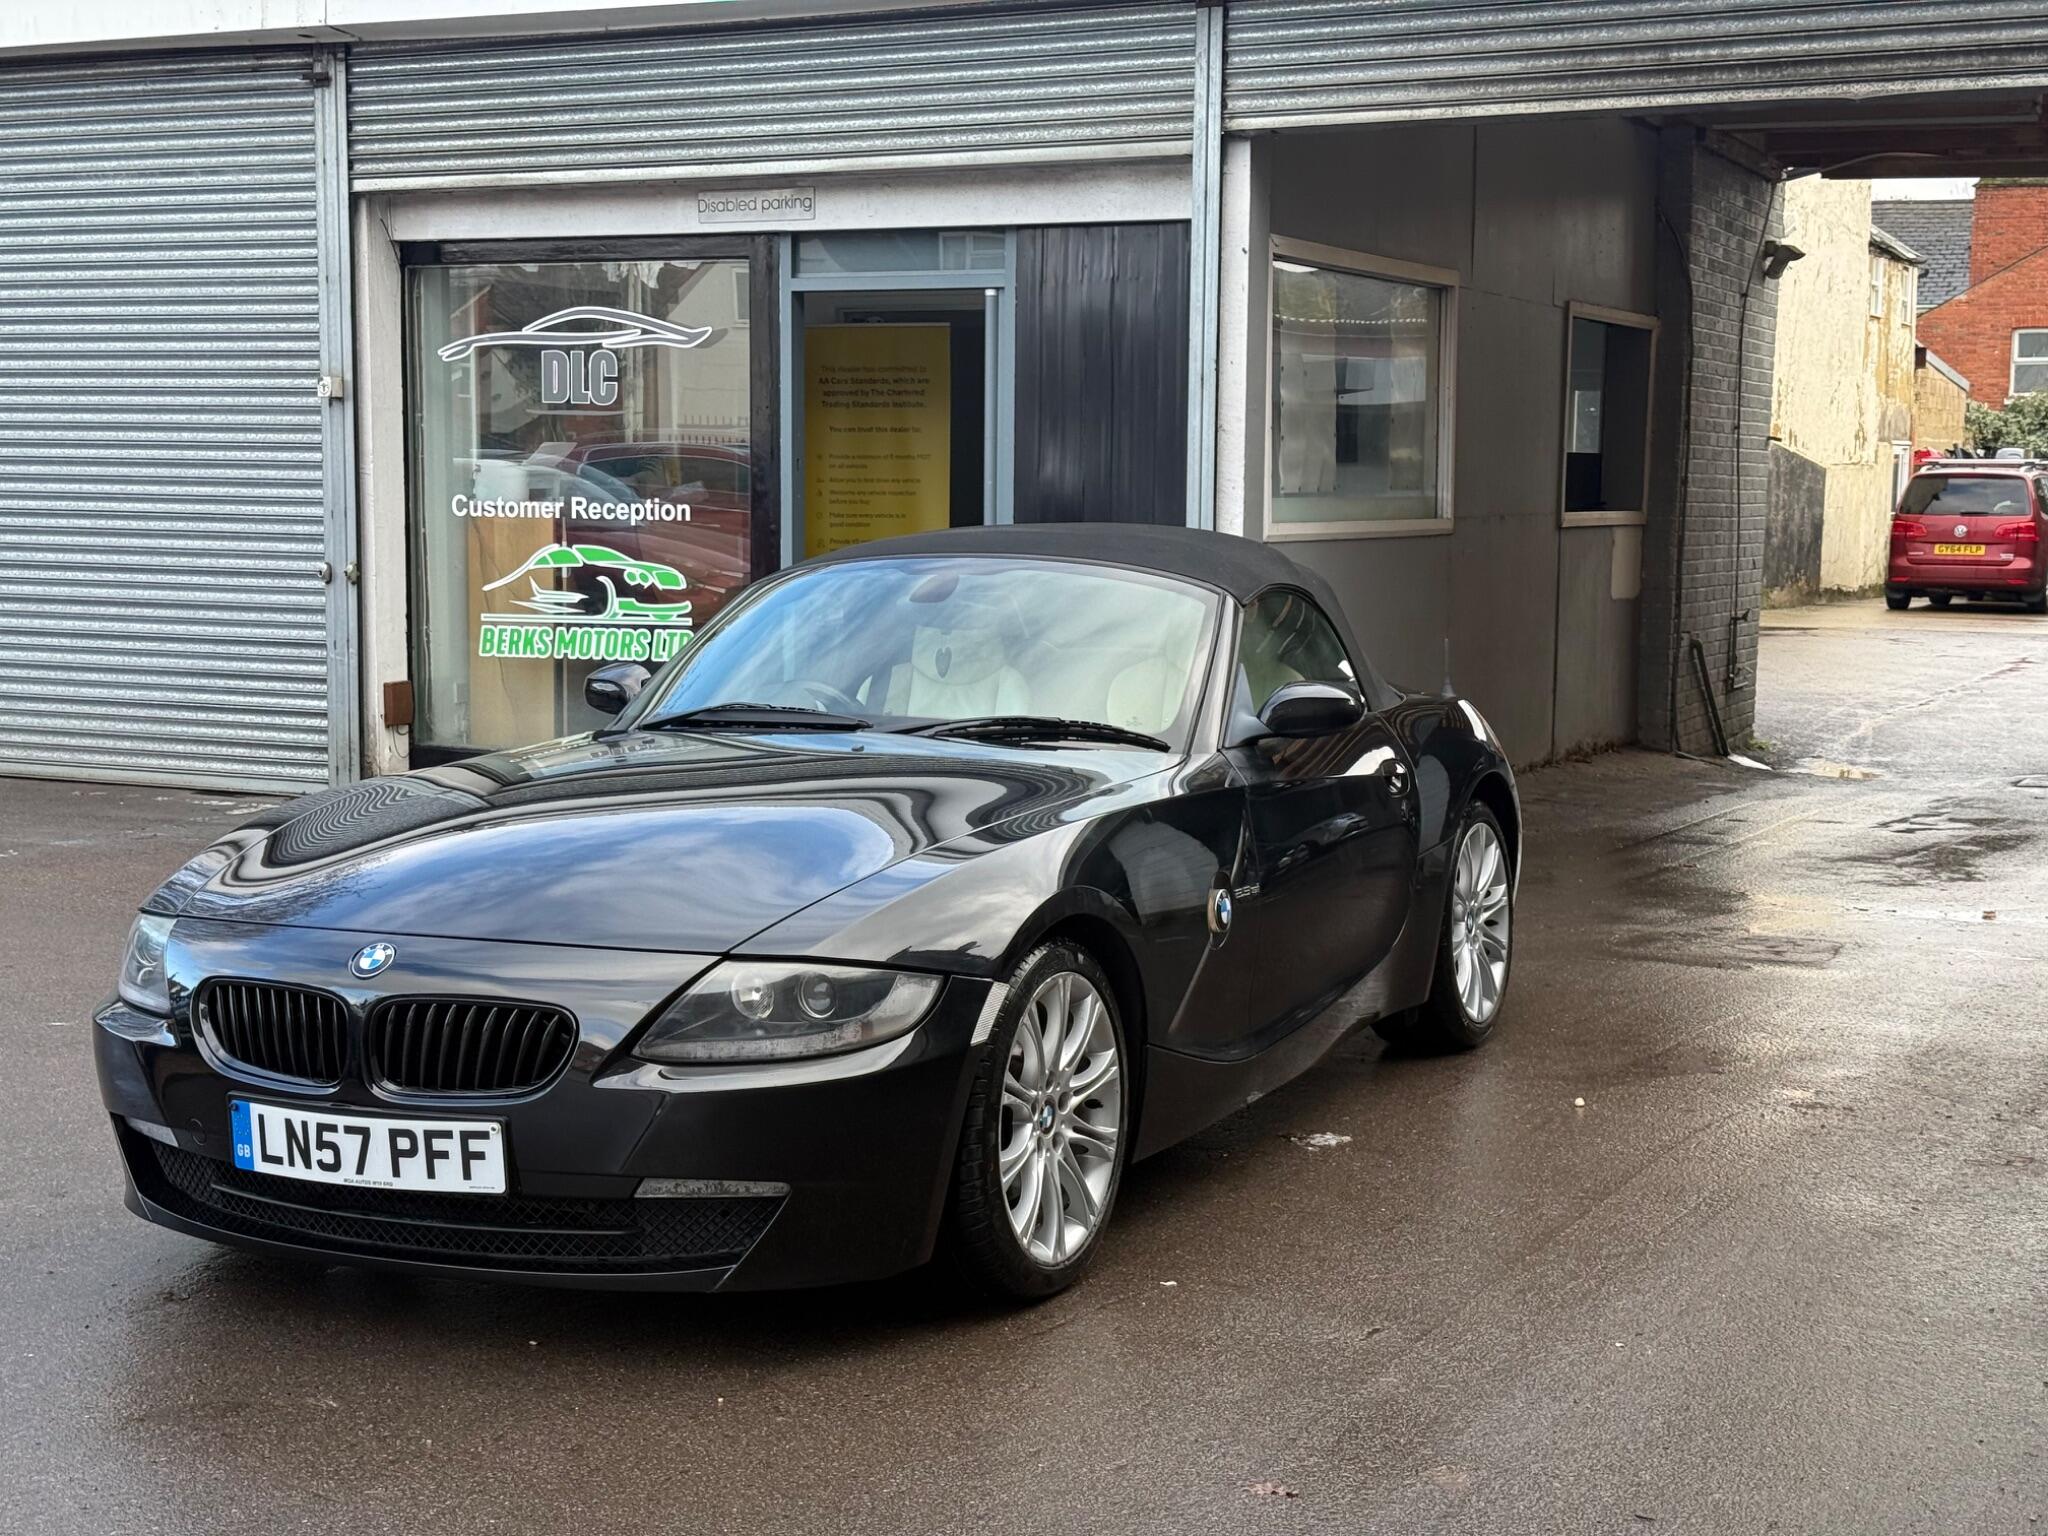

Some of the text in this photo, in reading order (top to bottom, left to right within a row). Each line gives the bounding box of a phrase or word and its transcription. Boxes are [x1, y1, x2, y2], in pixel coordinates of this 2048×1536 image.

[698, 194, 812, 213] Disabled parking
[541, 350, 618, 405] DLC
[451, 494, 691, 526] Customer Reception
[1938, 545, 1982, 554] GY64 FLP
[479, 625, 553, 657] BERKS
[554, 627, 652, 660] MOTORS
[237, 1143, 251, 1158] GB
[257, 1113, 491, 1181] LN57 PFF
